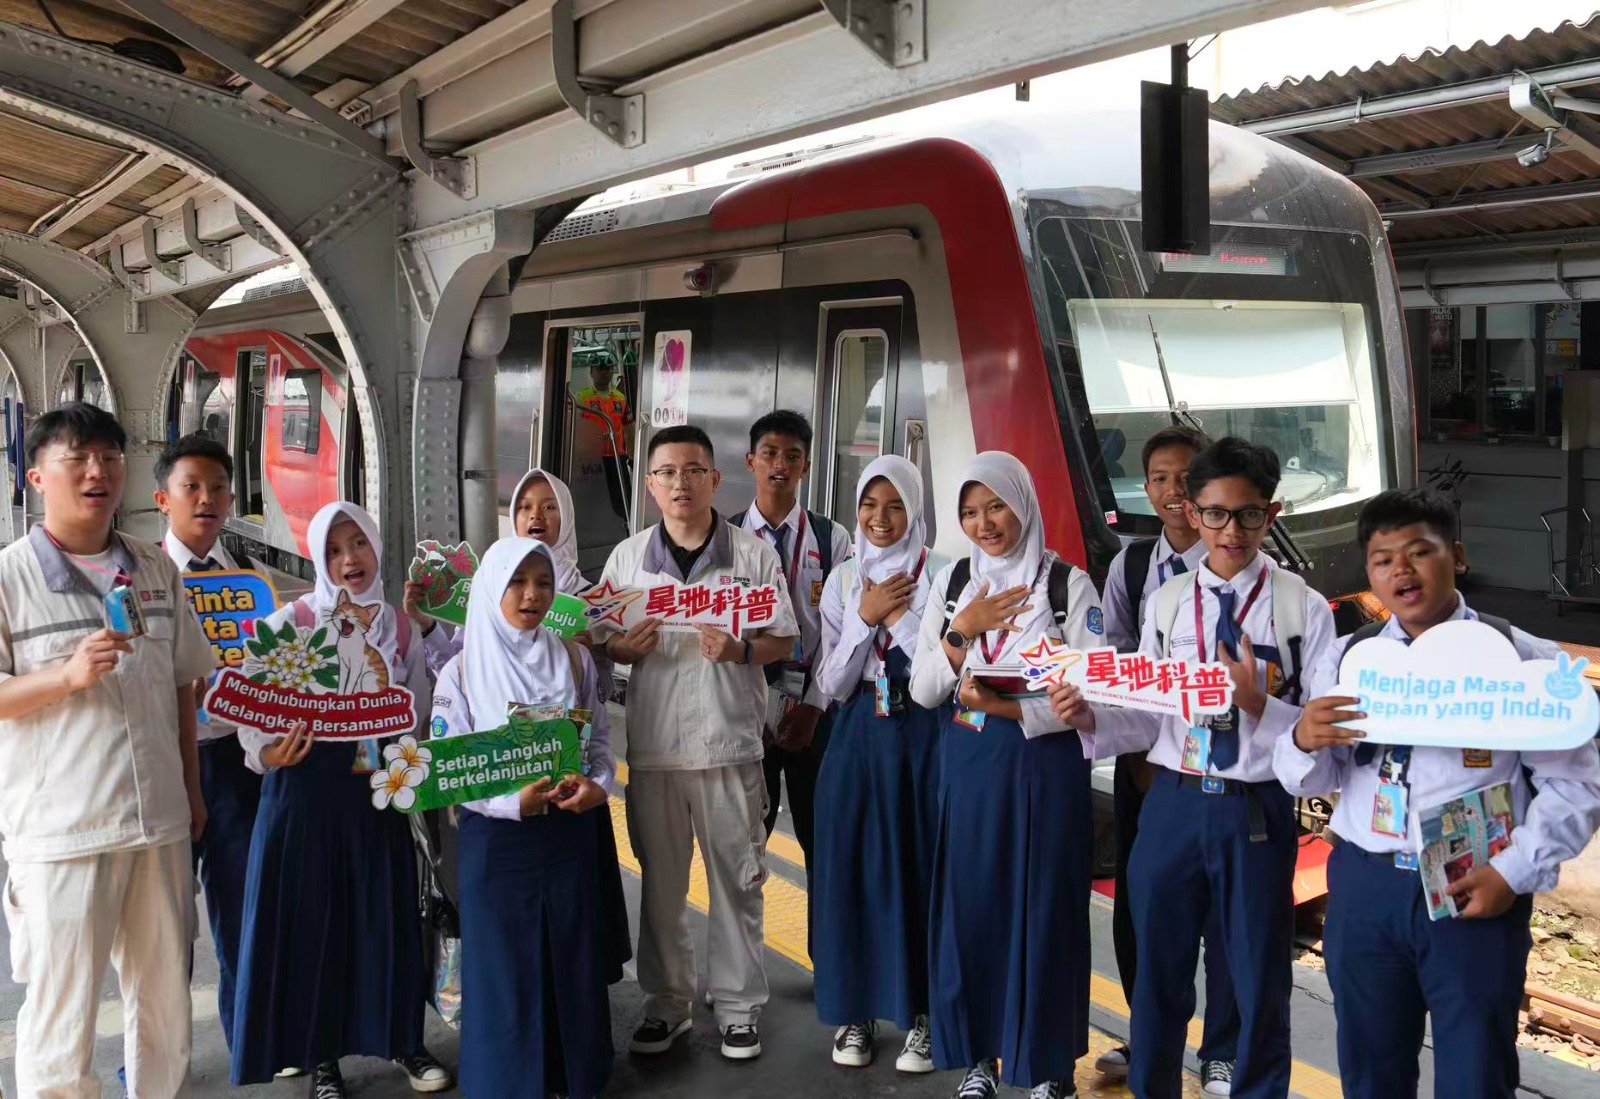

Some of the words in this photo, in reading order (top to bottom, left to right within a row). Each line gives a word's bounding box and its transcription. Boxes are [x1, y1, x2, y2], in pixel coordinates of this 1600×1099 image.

[545, 610, 577, 627] nuju
[225, 676, 355, 713] Menghubungkan
[359, 692, 407, 710] Dunia,
[1358, 669, 1455, 699] Menjaga
[1463, 676, 1525, 693] Masa
[312, 712, 410, 733] Bersamamu
[1356, 694, 1428, 718] Depan
[1435, 699, 1494, 720] yang
[1502, 698, 1572, 721] Indah
[435, 753, 488, 774] Setiap
[493, 737, 563, 763] Langkah
[438, 759, 553, 791] Berkelanjutan
